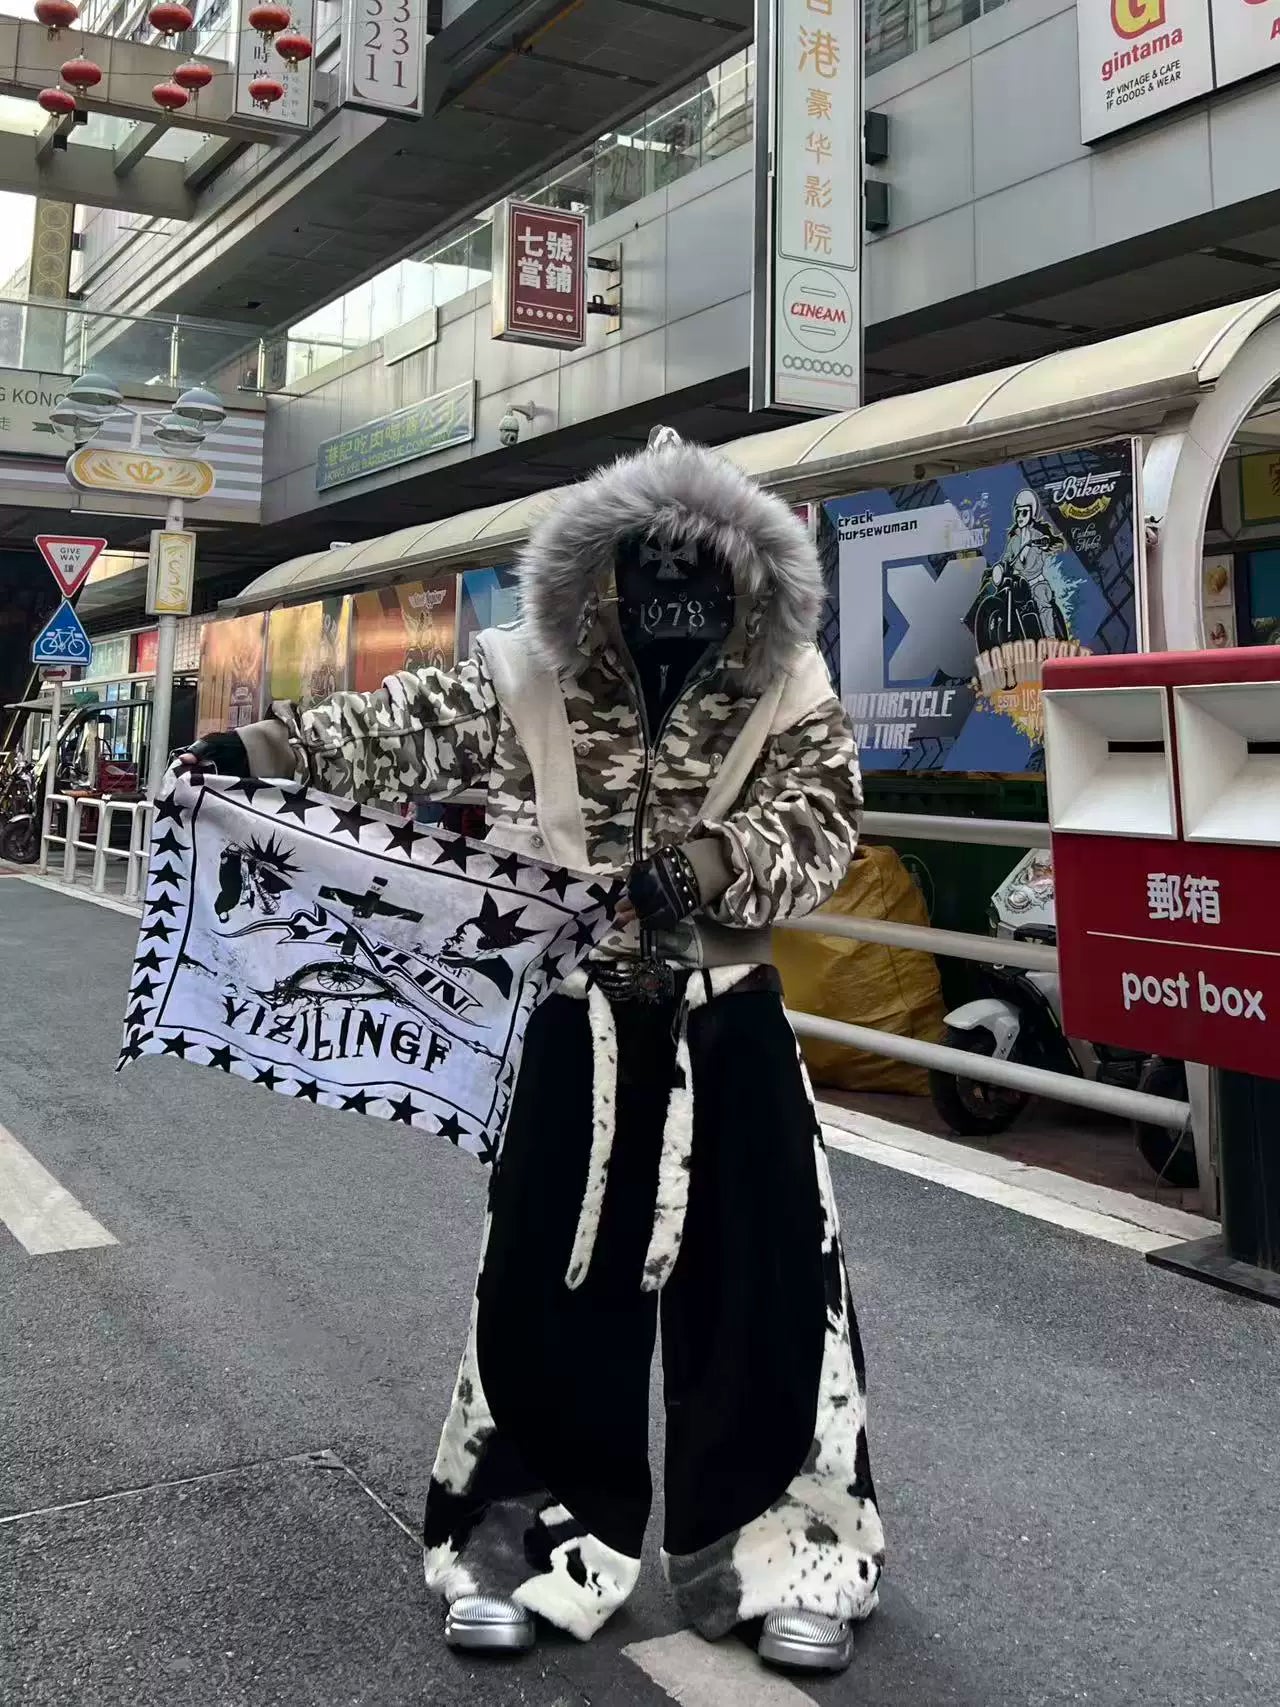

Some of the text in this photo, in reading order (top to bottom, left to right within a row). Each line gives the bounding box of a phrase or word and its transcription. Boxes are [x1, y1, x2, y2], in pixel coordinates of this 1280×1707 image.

[1101, 28, 1184, 81] gintama
[1106, 60, 1182, 100] 2F VINTAGE & CAFE
[1116, 86, 1146, 106] GOODS
[1147, 82, 1155, 92] &
[1156, 72, 1182, 89] WEAR
[1052, 472, 1117, 503] Bikers
[838, 511, 873, 527] crack
[60, 547, 80, 555] GIVE
[640, 599, 705, 630] 1978
[1147, 873, 1221, 924] 郵箱
[1122, 971, 1266, 1021] post box
